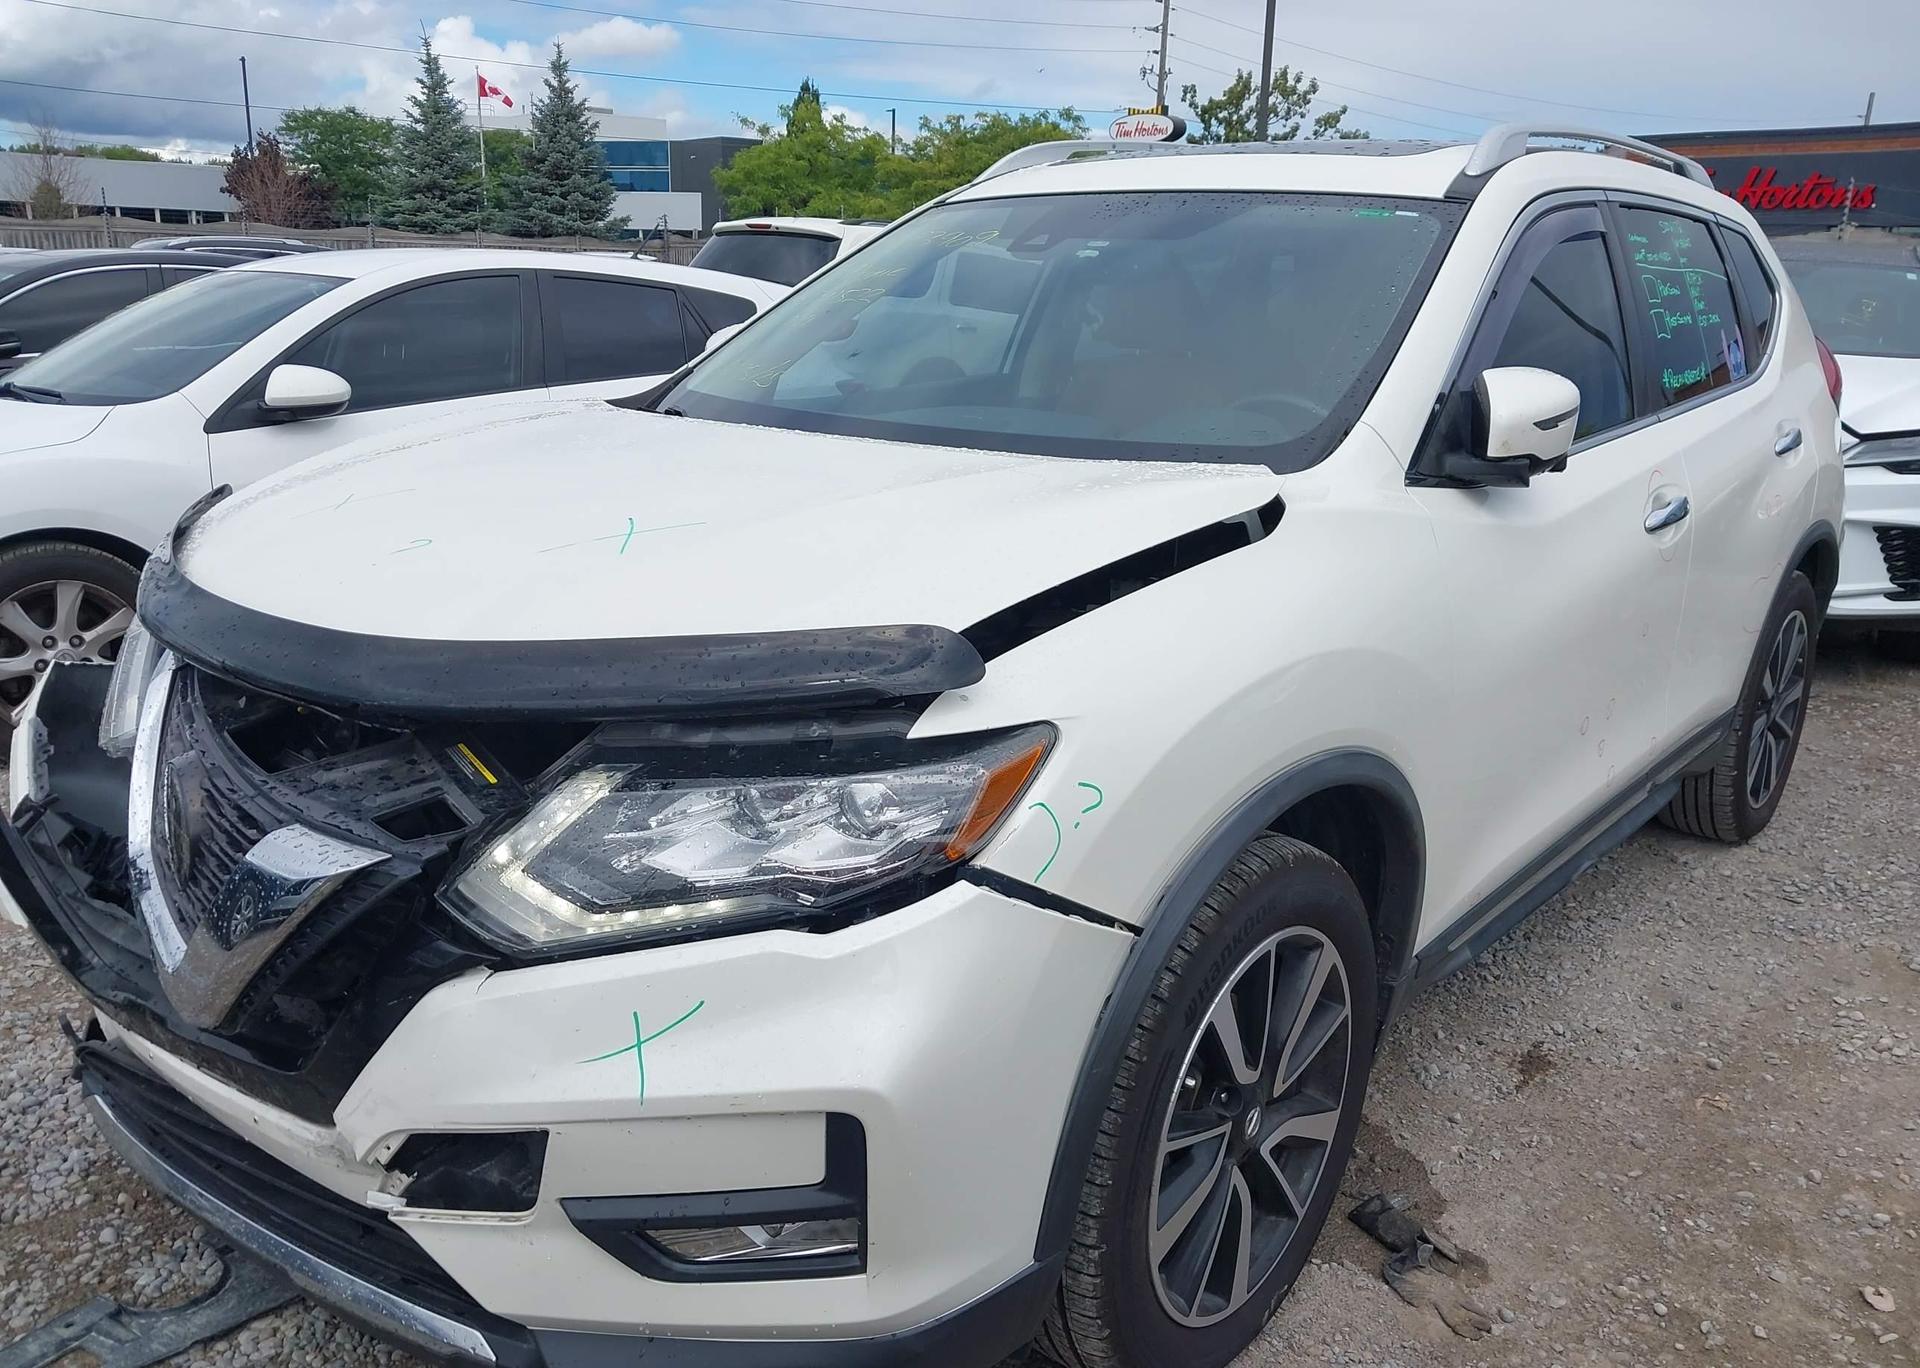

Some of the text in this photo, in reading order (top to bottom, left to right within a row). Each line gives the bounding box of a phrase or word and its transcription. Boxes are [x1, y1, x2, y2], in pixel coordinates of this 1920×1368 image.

[1115, 120, 1169, 139] Tim Hortons
[1736, 165, 1876, 210] Hortons
